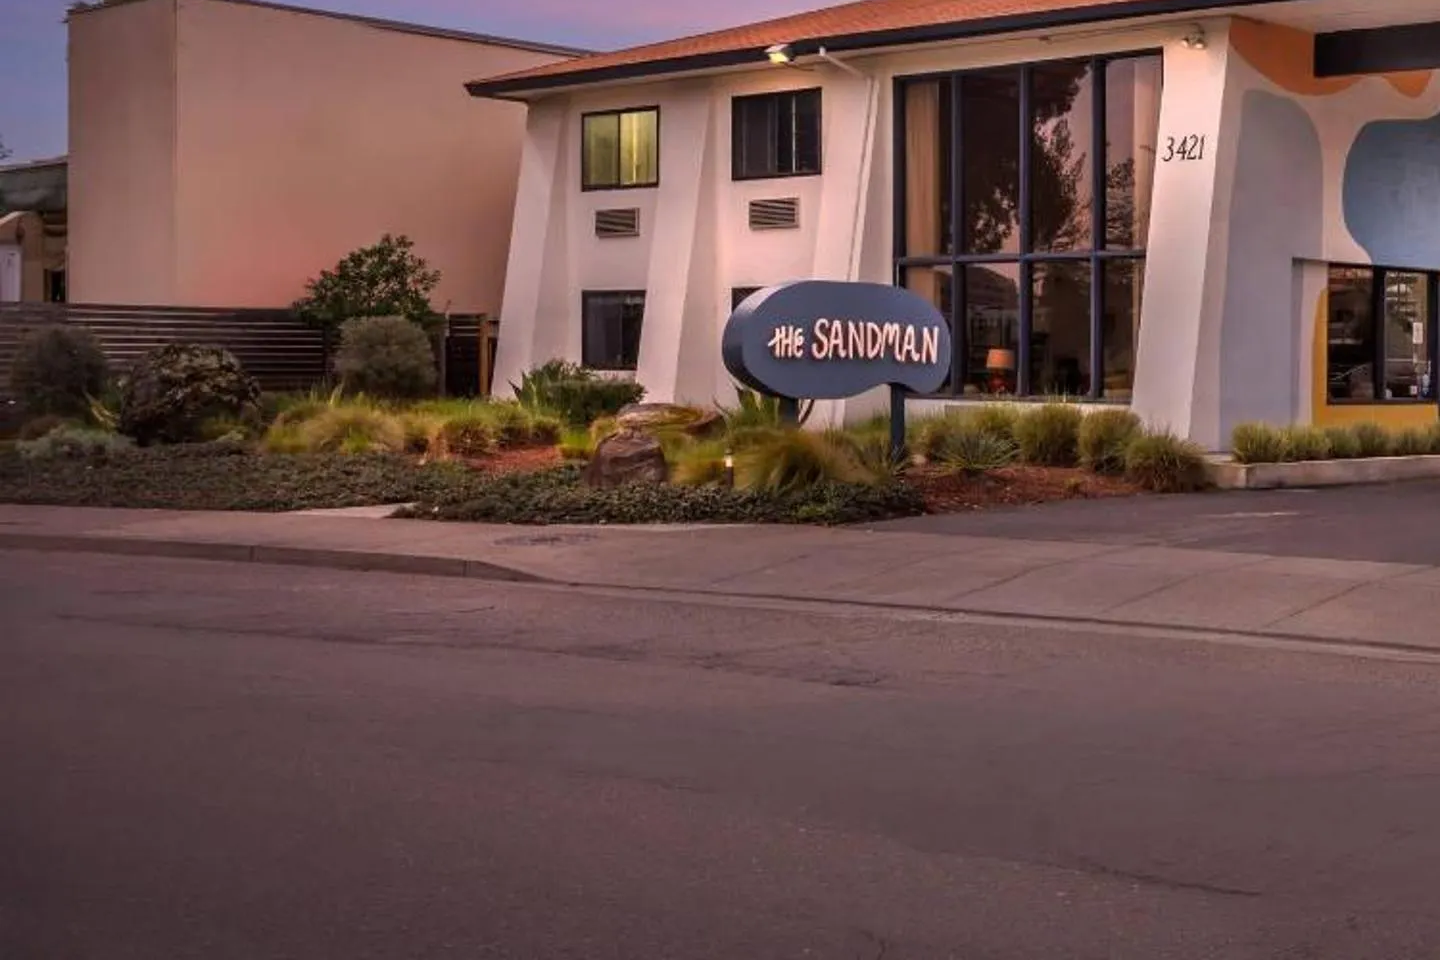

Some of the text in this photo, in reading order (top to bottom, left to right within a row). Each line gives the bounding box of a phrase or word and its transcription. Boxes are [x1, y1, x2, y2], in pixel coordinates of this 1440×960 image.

[1161, 134, 1206, 162] 3421
[768, 318, 940, 365] THE SANDMAN
